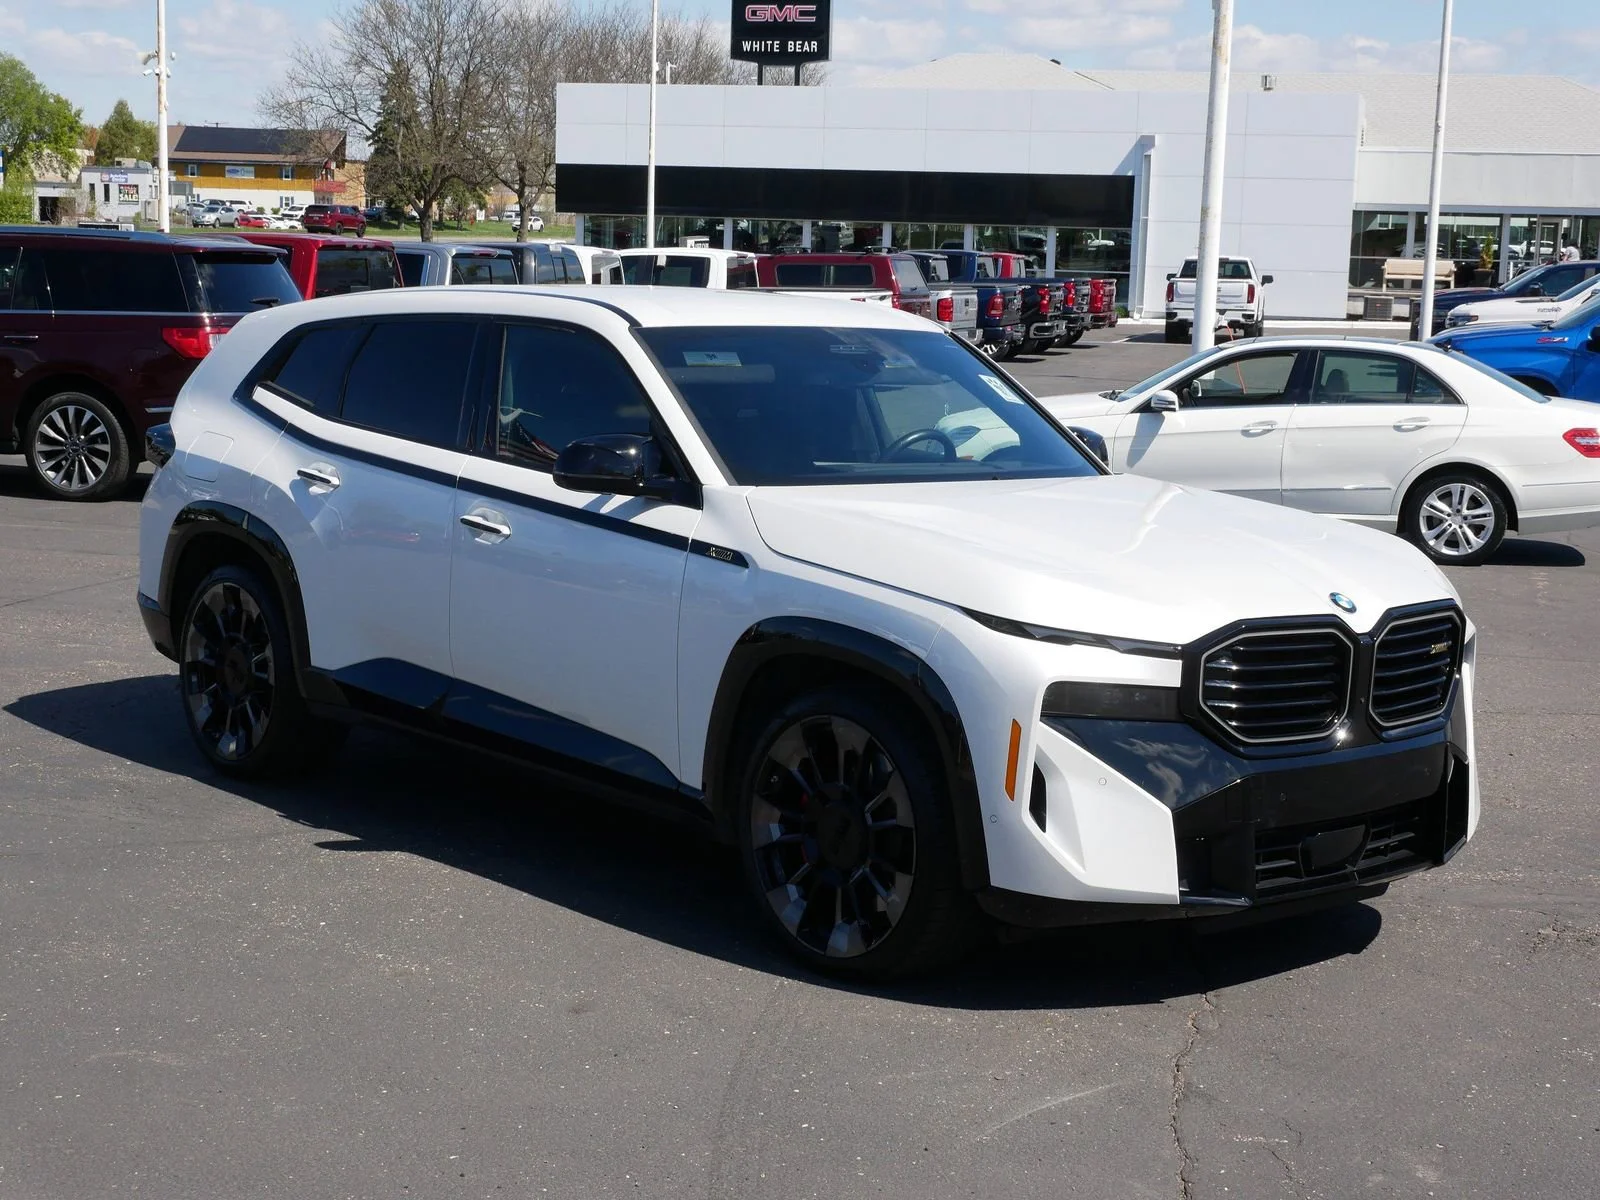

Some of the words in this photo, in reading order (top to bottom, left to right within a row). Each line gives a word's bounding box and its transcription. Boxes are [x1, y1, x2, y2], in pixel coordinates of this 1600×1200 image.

[745, 4, 817, 22] GMC
[742, 41, 780, 52] WHITE
[787, 41, 818, 52] BEAR
